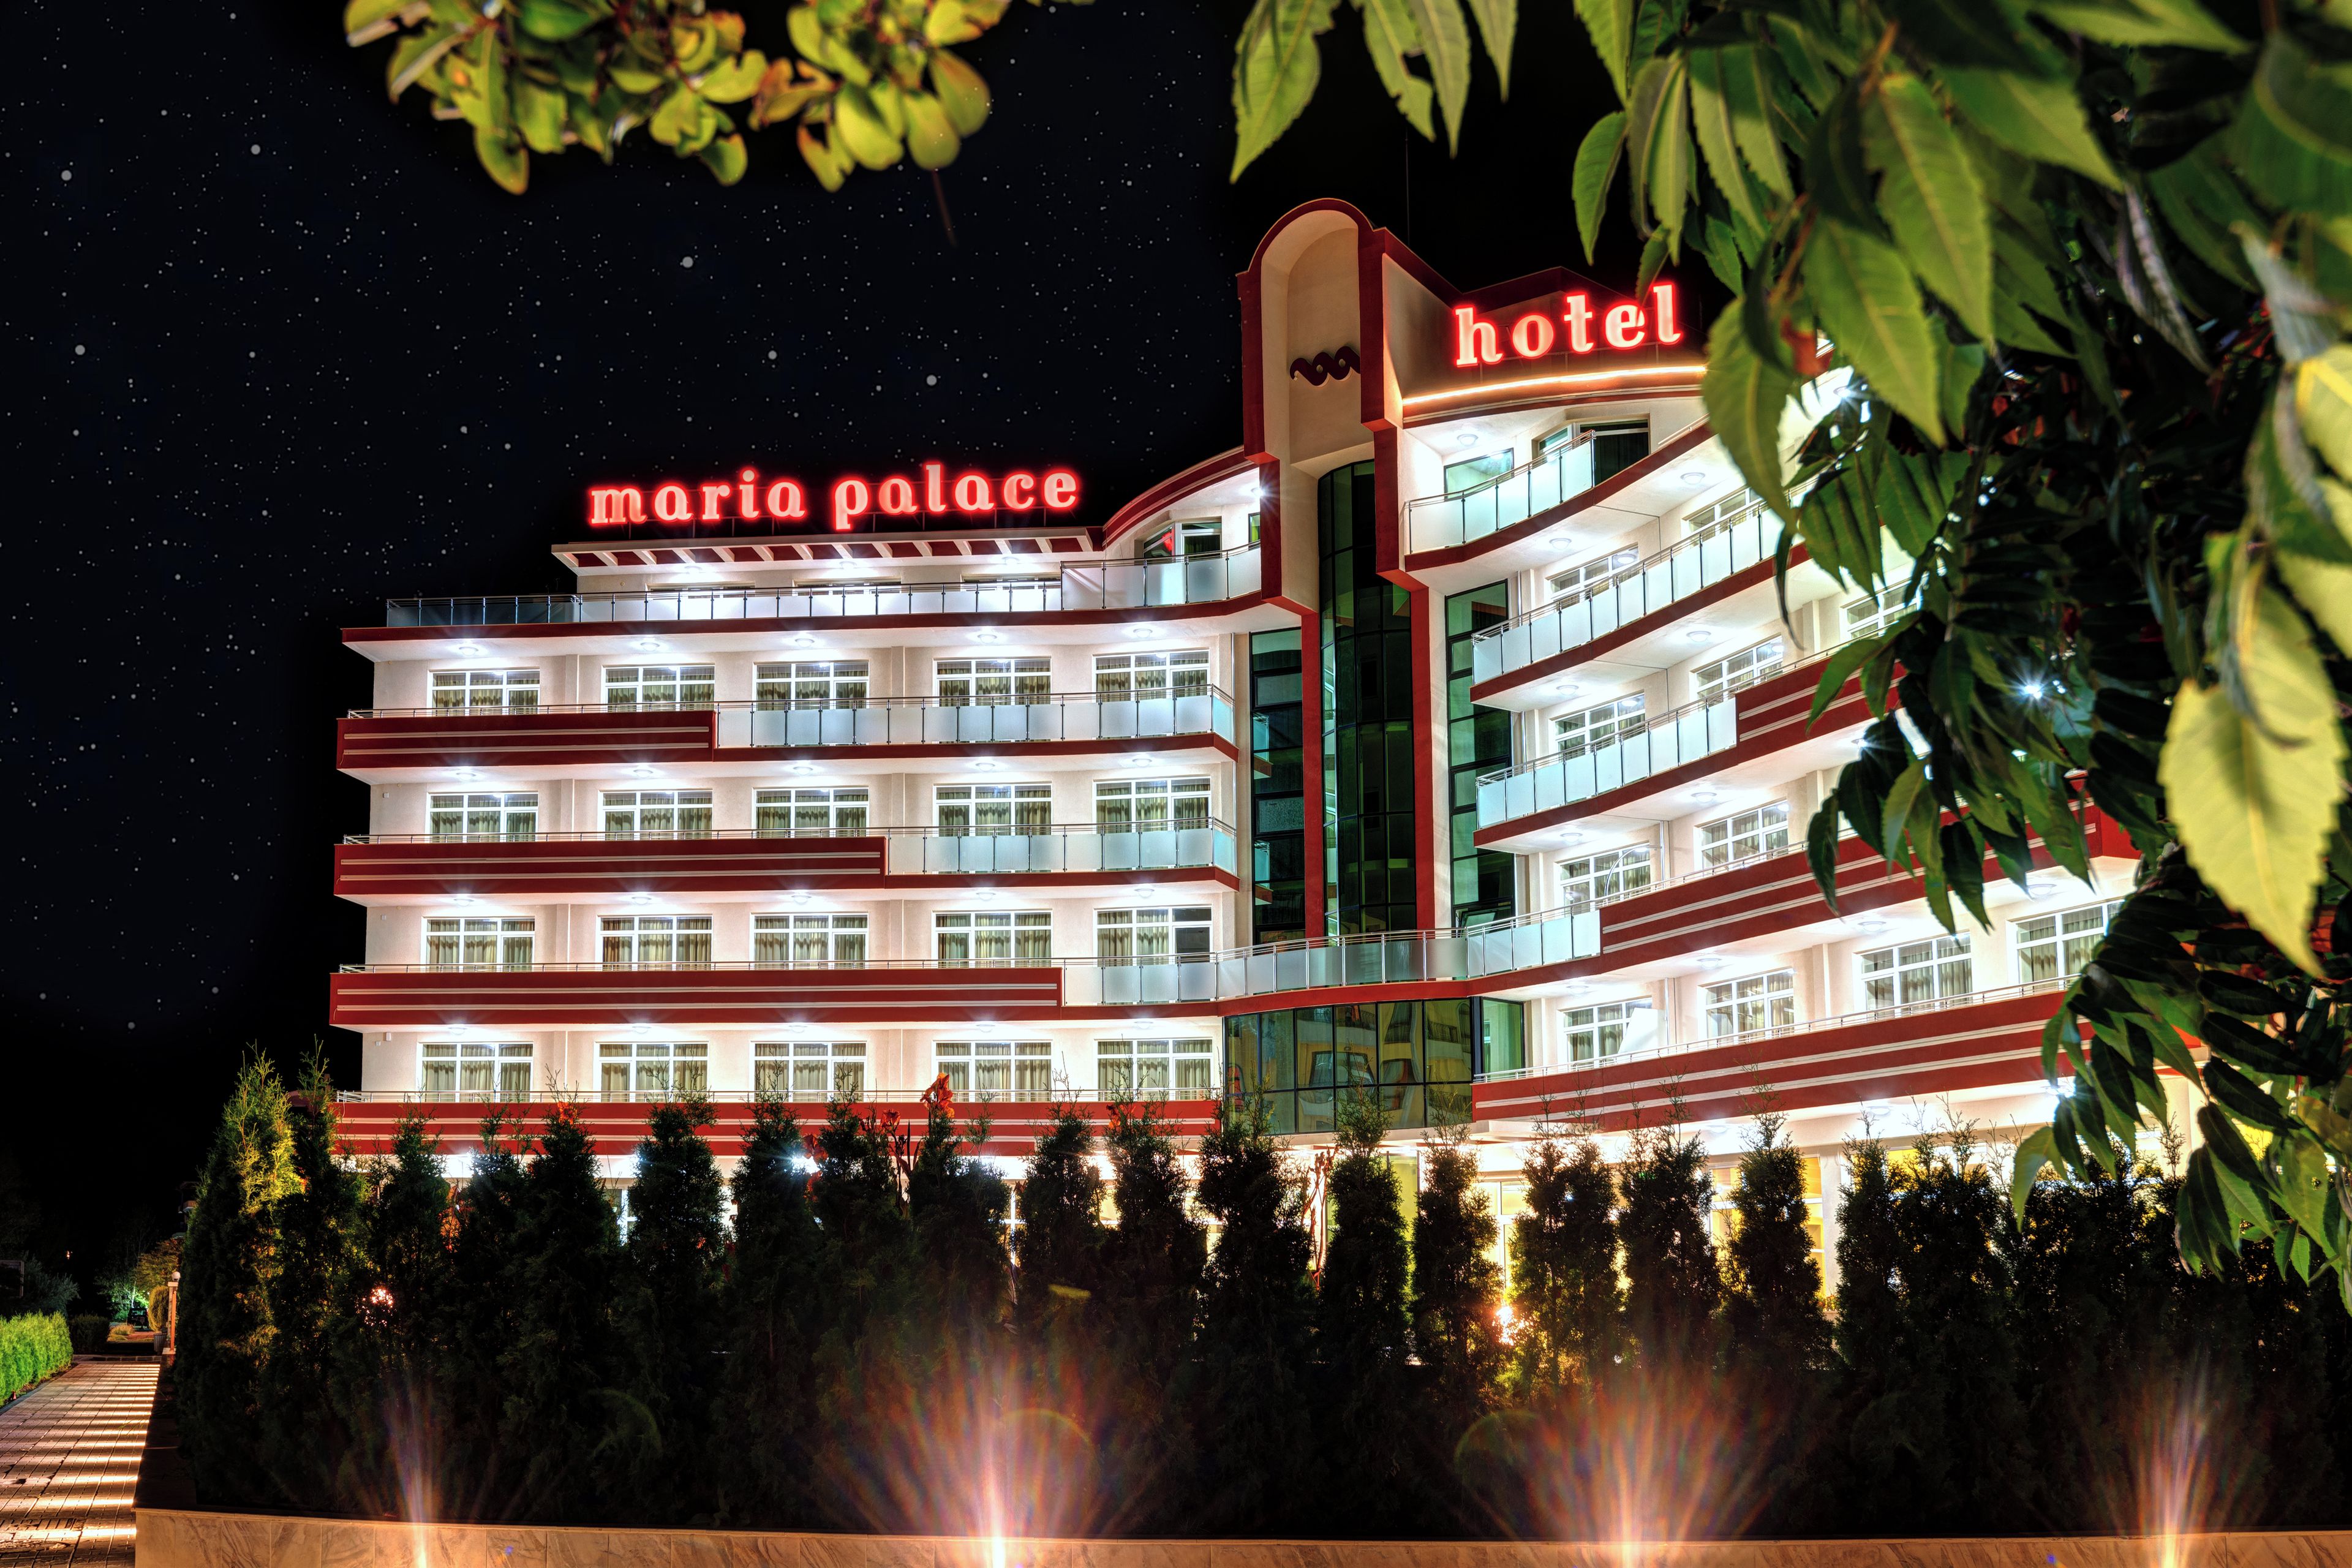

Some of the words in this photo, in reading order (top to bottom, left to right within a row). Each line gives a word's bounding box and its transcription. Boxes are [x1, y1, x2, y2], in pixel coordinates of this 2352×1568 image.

[1454, 283, 1682, 368] hotel
[590, 469, 807, 525] maria
[834, 463, 1077, 531] palace
